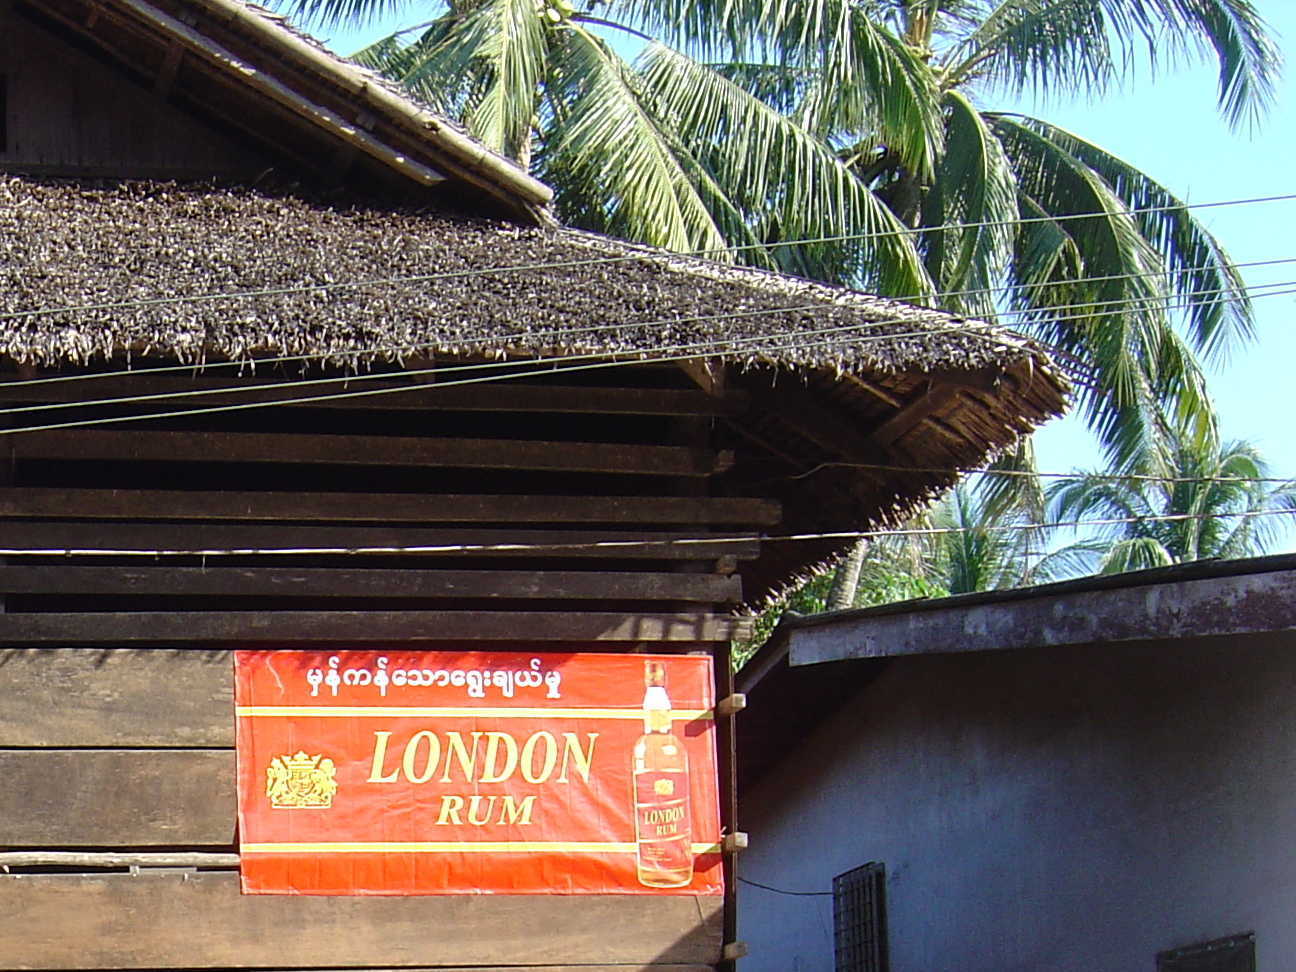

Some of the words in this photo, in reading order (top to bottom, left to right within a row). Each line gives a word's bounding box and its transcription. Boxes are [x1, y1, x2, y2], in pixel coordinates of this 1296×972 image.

[306, 656, 562, 698] မှန်ကန်သောရွေးချယ်မှု
[366, 730, 599, 785] LONDON
[435, 795, 537, 826] RUM
[644, 806, 685, 825] LONDON
[656, 823, 678, 836] RUM
